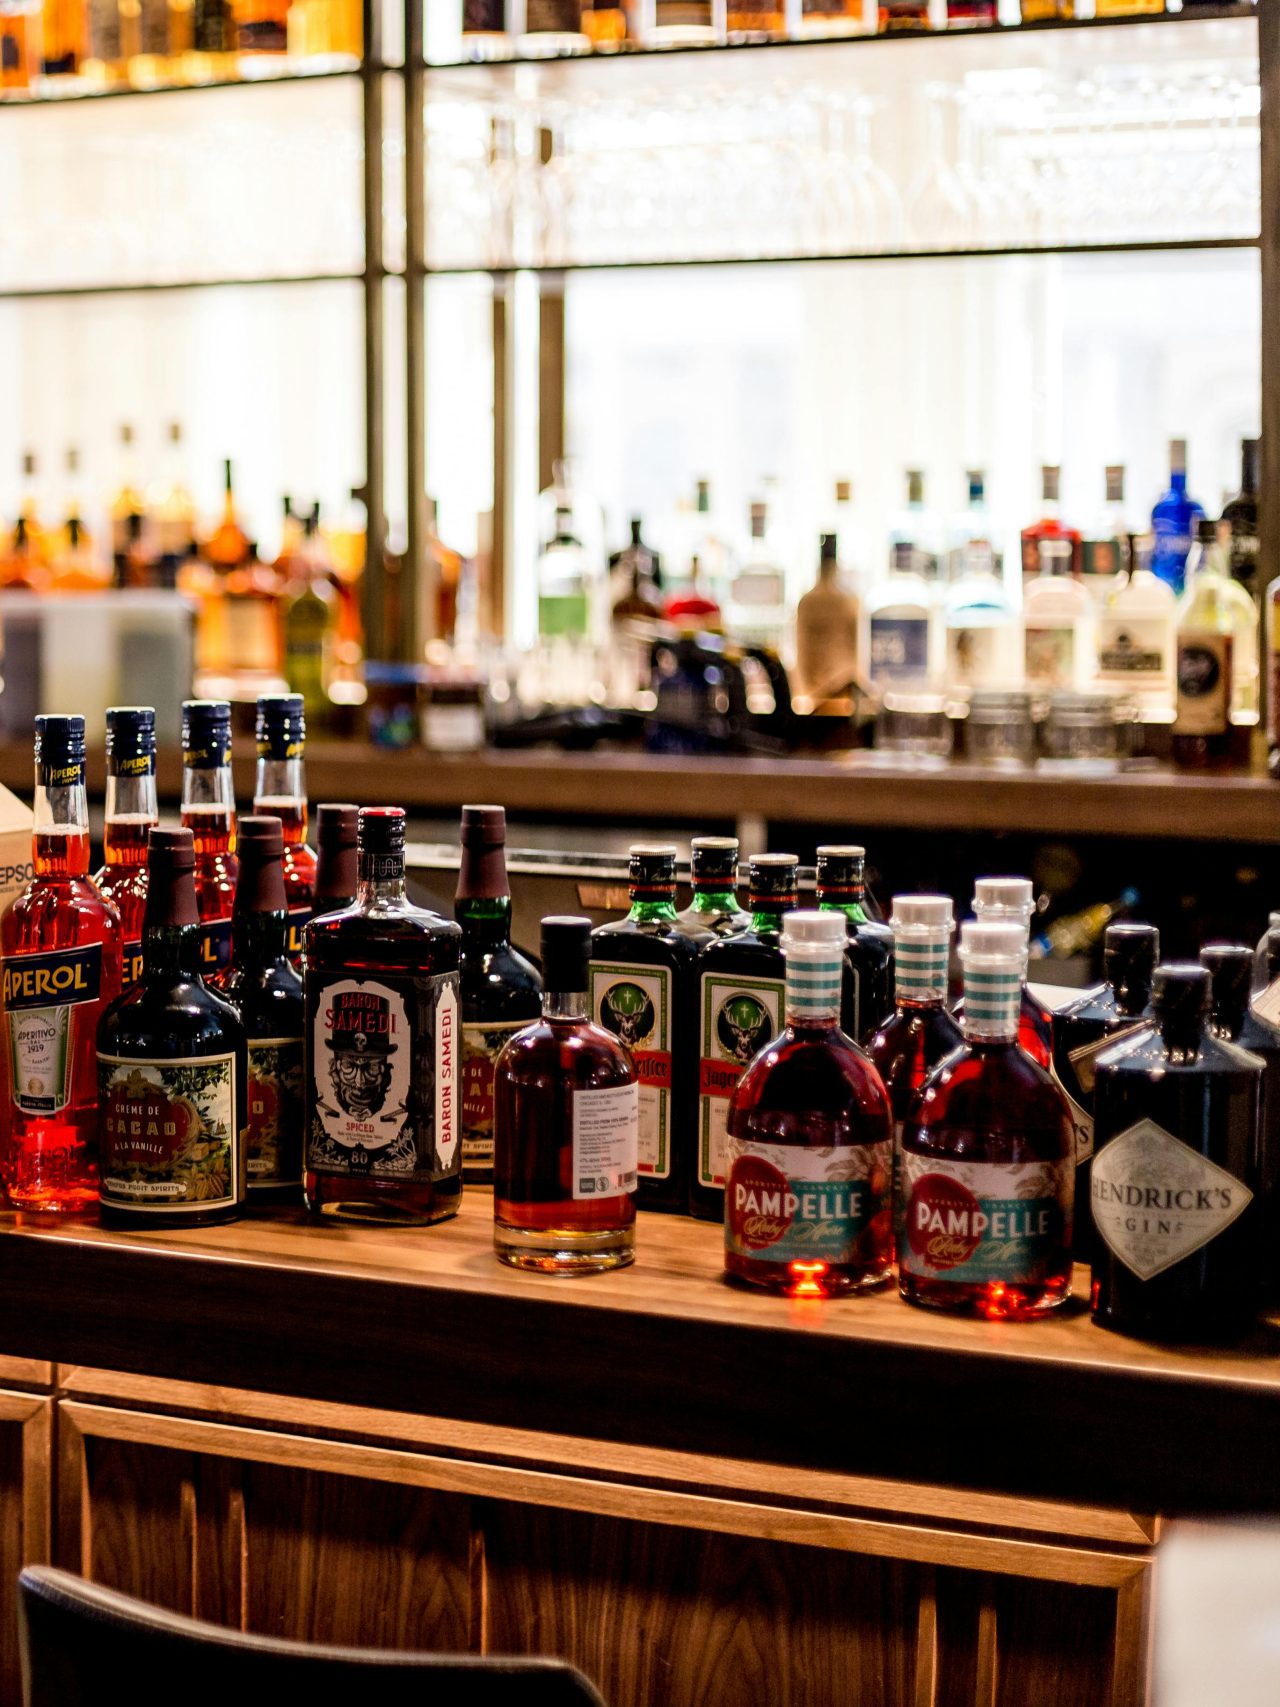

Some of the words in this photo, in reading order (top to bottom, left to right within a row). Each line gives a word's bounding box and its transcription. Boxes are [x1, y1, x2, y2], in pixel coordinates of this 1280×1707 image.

[3, 963, 87, 1003] APEROL
[341, 993, 380, 1011] BARON
[324, 1008, 397, 1034] SAMEDI
[18, 1028, 56, 1040] APERITIVO
[442, 1007, 452, 1079] SAMEDI
[28, 1044, 44, 1054] 1919
[148, 1106, 160, 1116] DE
[442, 1086, 452, 1144] BARON
[463, 1102, 487, 1114] NILLE
[106, 1117, 177, 1136] CACAO
[346, 1122, 375, 1133] SPICED
[120, 1141, 129, 1150] LA
[131, 1141, 164, 1155] VANILLE
[351, 1151, 368, 1165] 80
[735, 1182, 862, 1219] PAMPELLE
[1091, 1175, 1232, 1212] HENDRICK'S
[916, 1200, 1050, 1238] PAMPELLE
[1125, 1217, 1170, 1234] GIN
